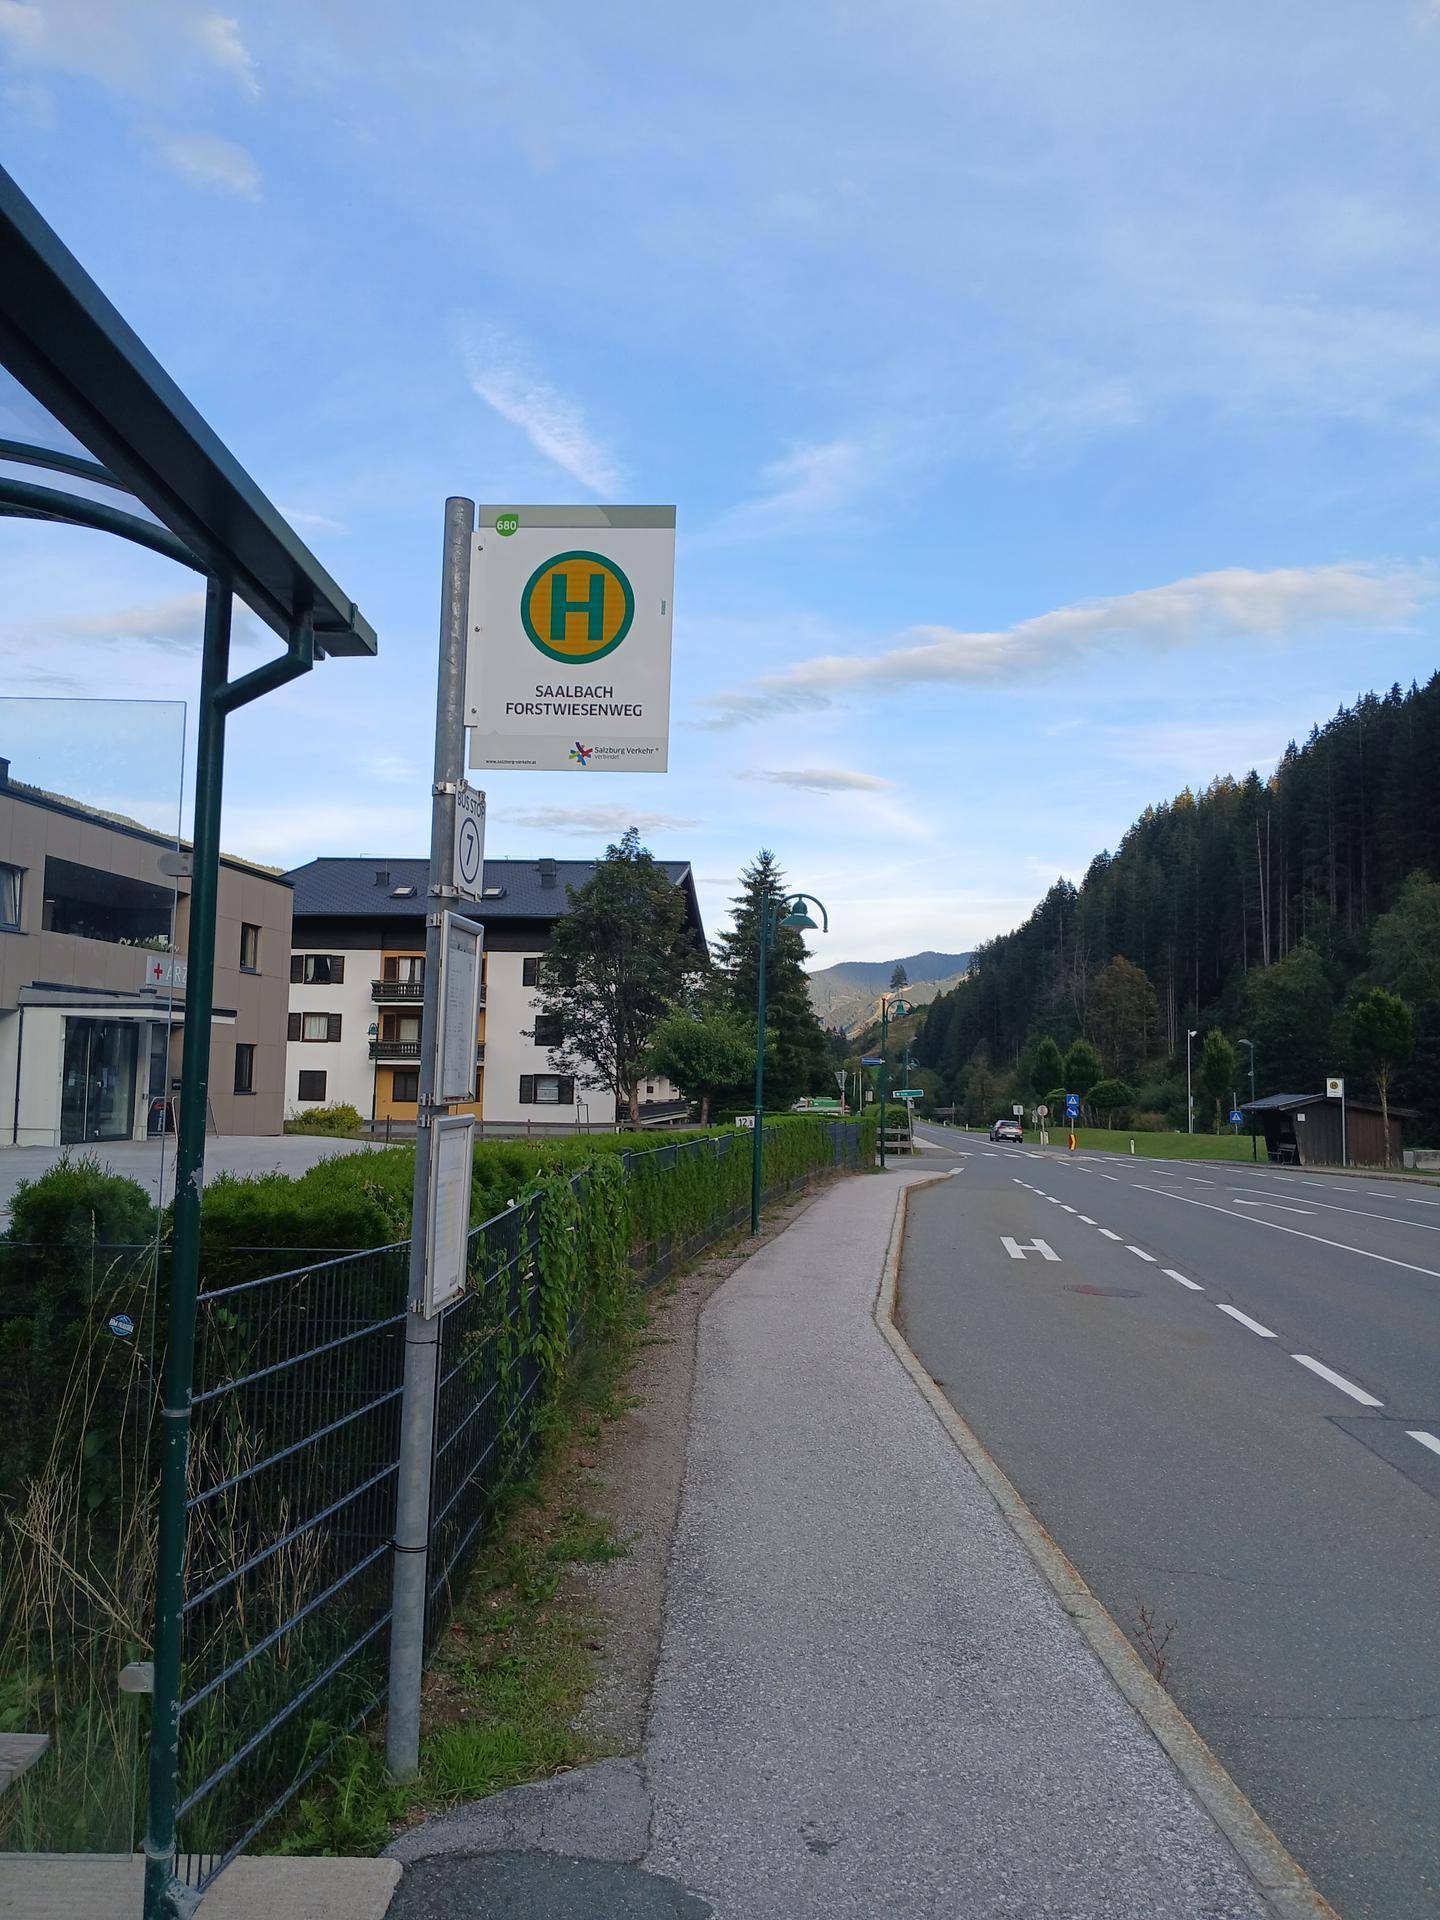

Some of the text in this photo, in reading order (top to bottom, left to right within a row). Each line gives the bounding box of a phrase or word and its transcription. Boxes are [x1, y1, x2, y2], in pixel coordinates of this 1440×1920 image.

[496, 520, 517, 531] 680
[550, 574, 605, 641] H
[535, 685, 613, 698] SAALBACH
[505, 702, 642, 716] FORSTWIESENWEG
[594, 746, 654, 755] Salzburg Verkehr
[457, 790, 485, 820] BUS STOP
[466, 833, 474, 867] 7
[166, 966, 187, 983] ARZ
[1000, 1236, 1063, 1261] H
